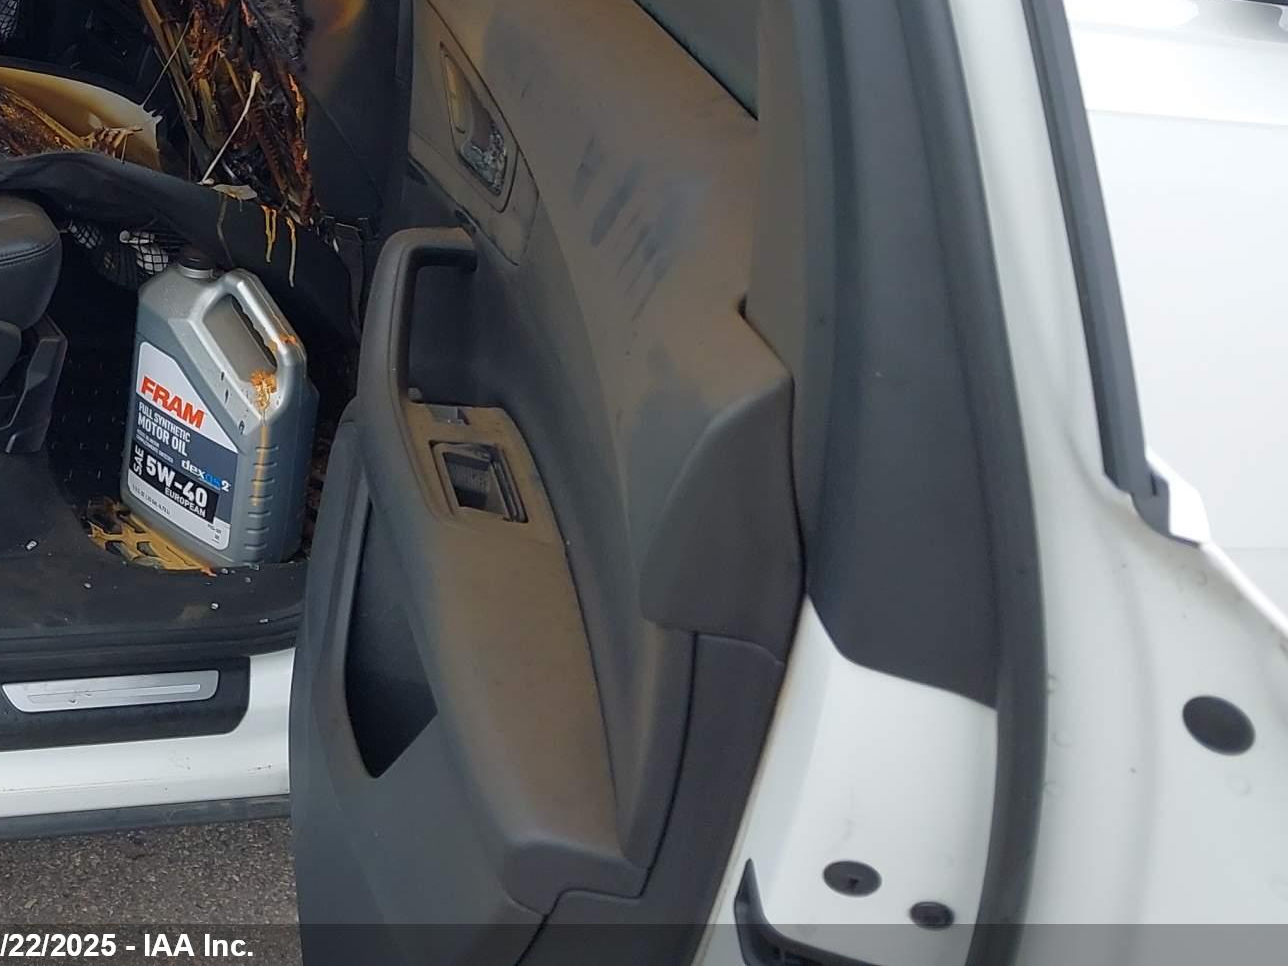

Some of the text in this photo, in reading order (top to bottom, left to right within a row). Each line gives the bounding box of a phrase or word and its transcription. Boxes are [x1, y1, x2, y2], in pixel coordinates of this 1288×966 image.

[139, 401, 153, 420] FULL
[154, 414, 191, 443] SYNTHETIC
[141, 376, 205, 429] FRAM
[138, 413, 170, 445] MOTOR
[171, 434, 188, 457] OIL
[133, 444, 145, 475] SAE
[146, 454, 208, 508] 5W-40
[165, 487, 206, 518] EUROPEAN
